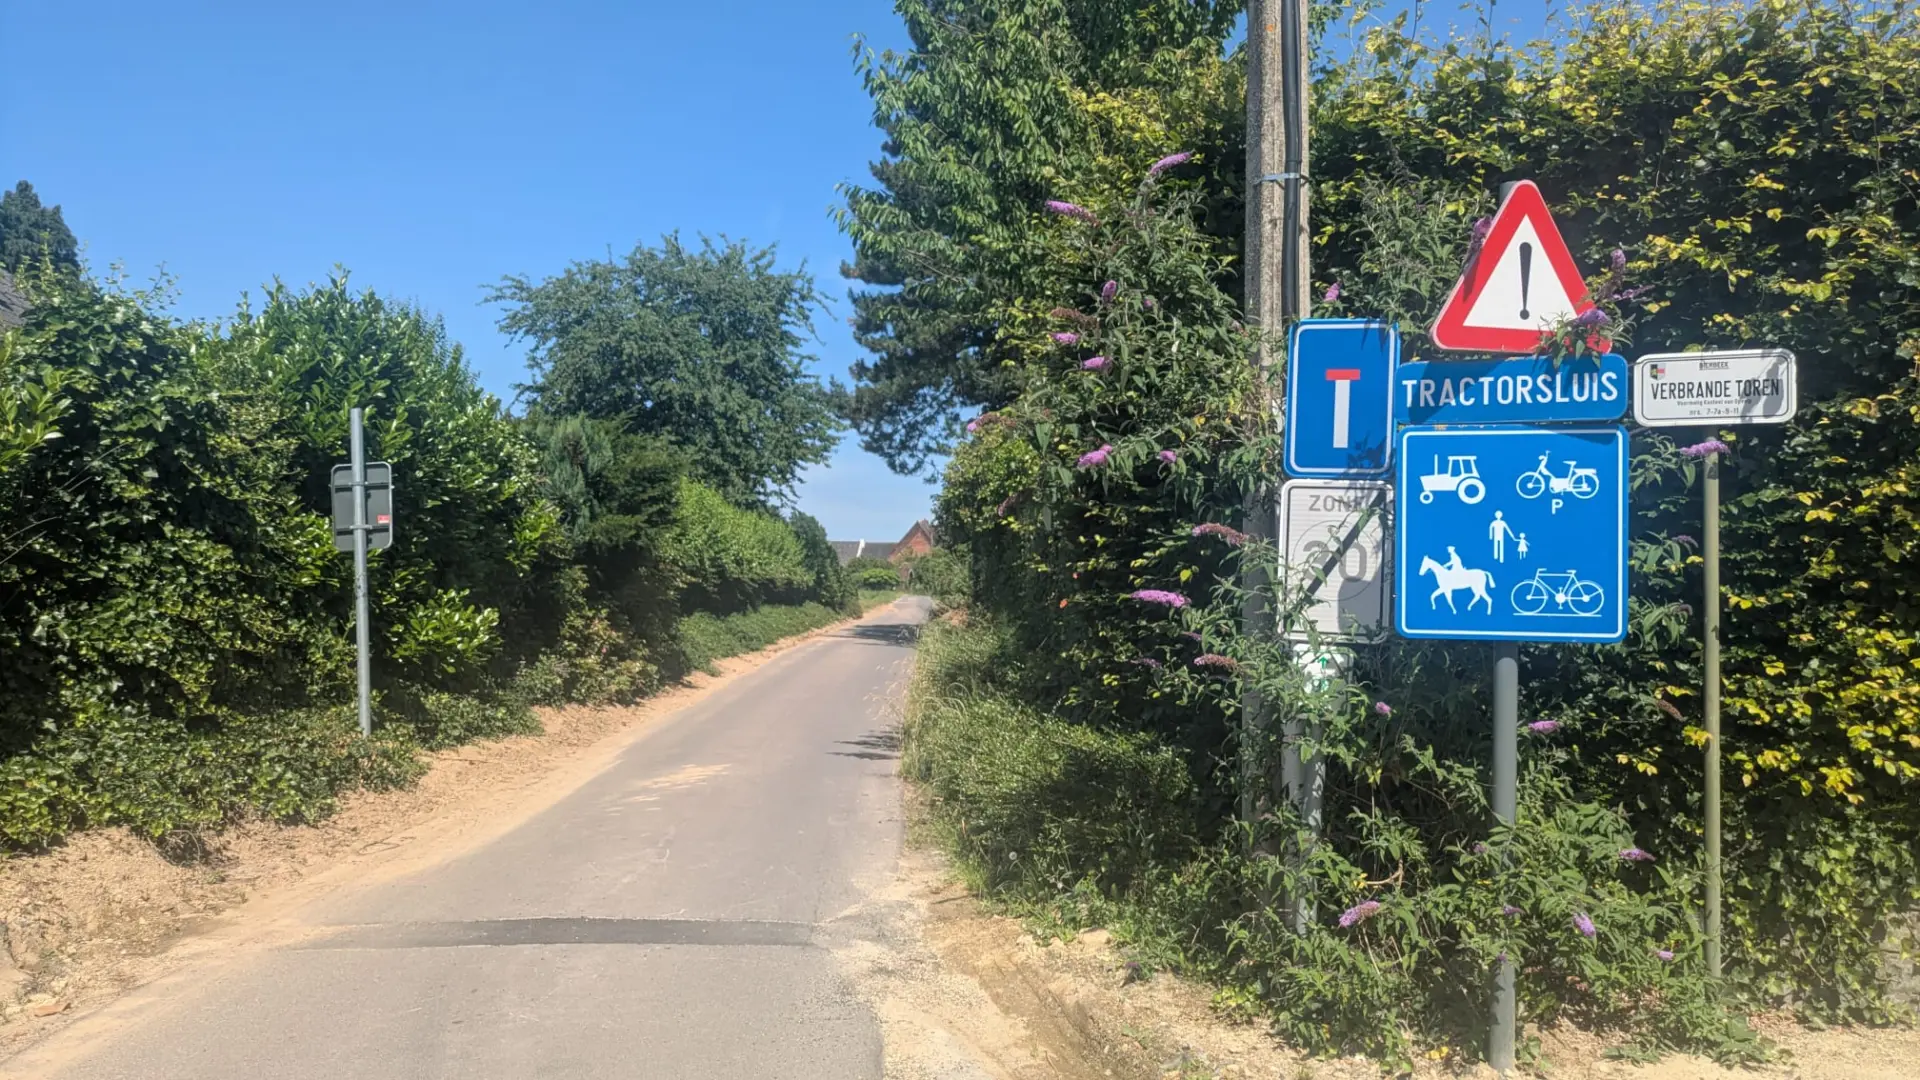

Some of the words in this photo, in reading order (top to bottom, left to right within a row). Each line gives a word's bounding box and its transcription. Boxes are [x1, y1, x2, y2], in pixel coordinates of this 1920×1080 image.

[1402, 371, 1619, 408] TRACTORSLUIS
[1651, 380, 1732, 399] VERBRANDE
[1735, 378, 1780, 397] TOREN
[1551, 498, 1564, 515] P
